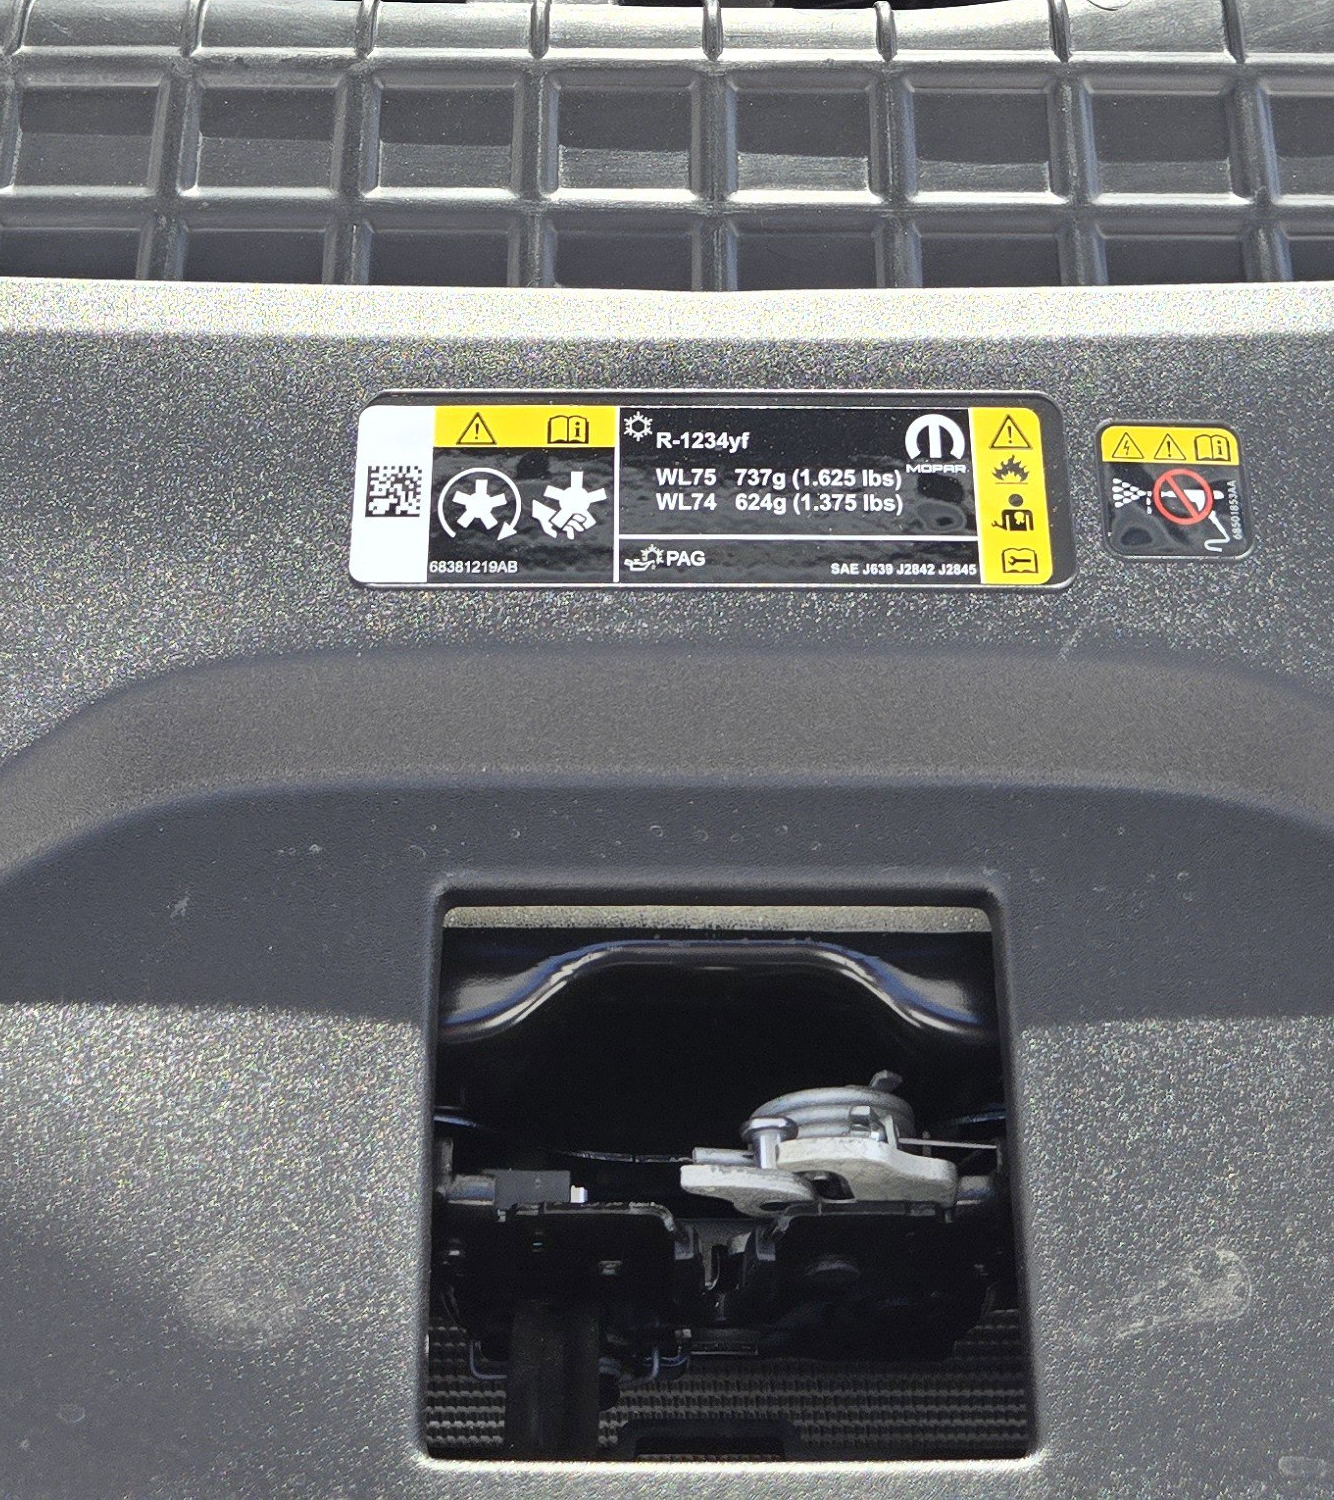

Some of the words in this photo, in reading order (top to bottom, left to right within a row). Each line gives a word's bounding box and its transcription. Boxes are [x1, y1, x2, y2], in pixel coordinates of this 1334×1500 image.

[656, 431, 750, 454] R-1234yf
[906, 463, 967, 474] MOPAR
[655, 468, 717, 486] WL75
[734, 468, 786, 490] 737g
[792, 468, 856, 491] (1.625
[862, 469, 902, 491] lbs)
[655, 493, 717, 511] WL74
[735, 493, 787, 515] 624g
[793, 493, 857, 515] (1.375
[863, 494, 904, 516] lbs)
[429, 560, 518, 574] 68381219AB
[666, 549, 706, 568] PAG
[830, 563, 860, 575] SAE
[863, 563, 894, 576] J639
[896, 563, 936, 576] J2842
[938, 563, 977, 576] J2845
